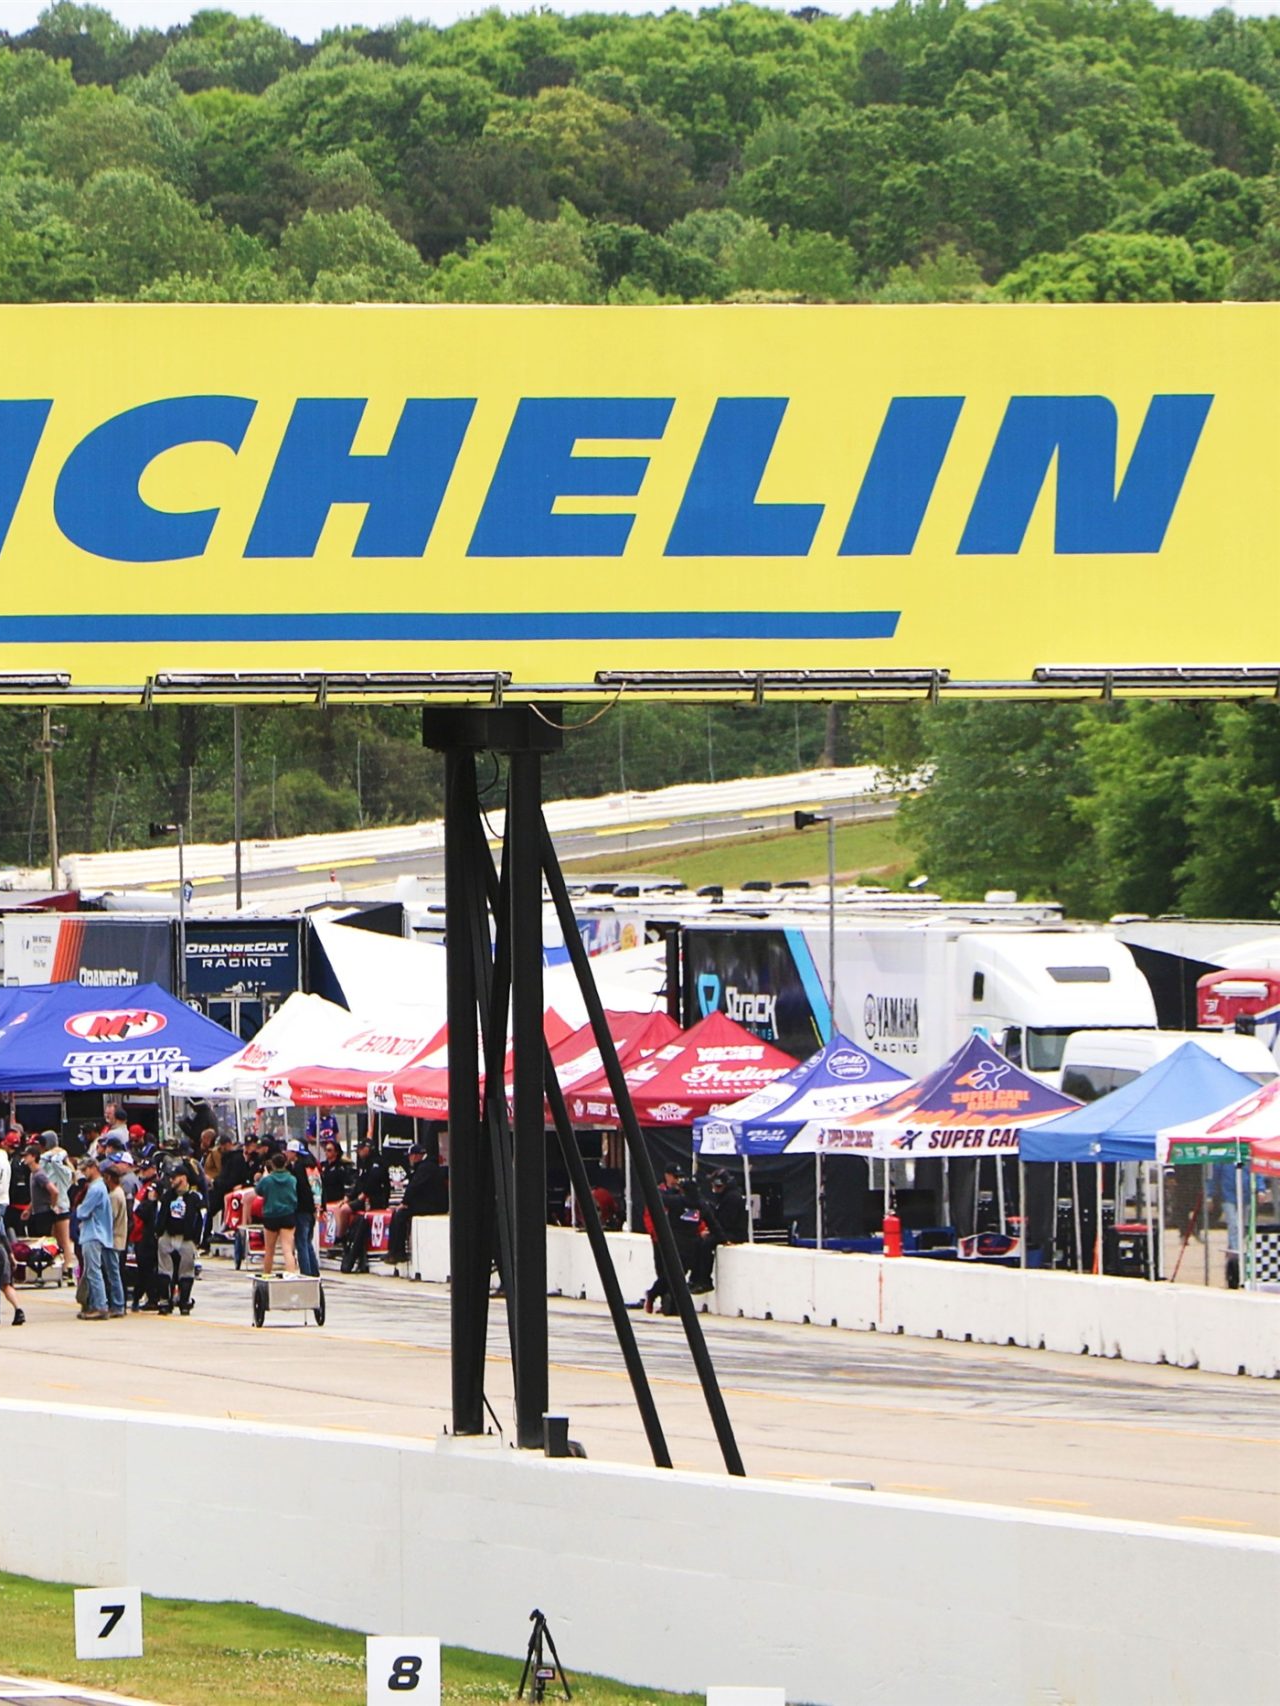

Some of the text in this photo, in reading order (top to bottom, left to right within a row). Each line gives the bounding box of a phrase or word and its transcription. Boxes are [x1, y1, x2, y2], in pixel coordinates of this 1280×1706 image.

[202, 958, 272, 968] RACING
[876, 997, 919, 1038] YAMAHA
[874, 1042, 918, 1054] RACING
[928, 1130, 983, 1149] SUPER
[99, 1605, 125, 1638] 7
[388, 1656, 422, 1690] 8
